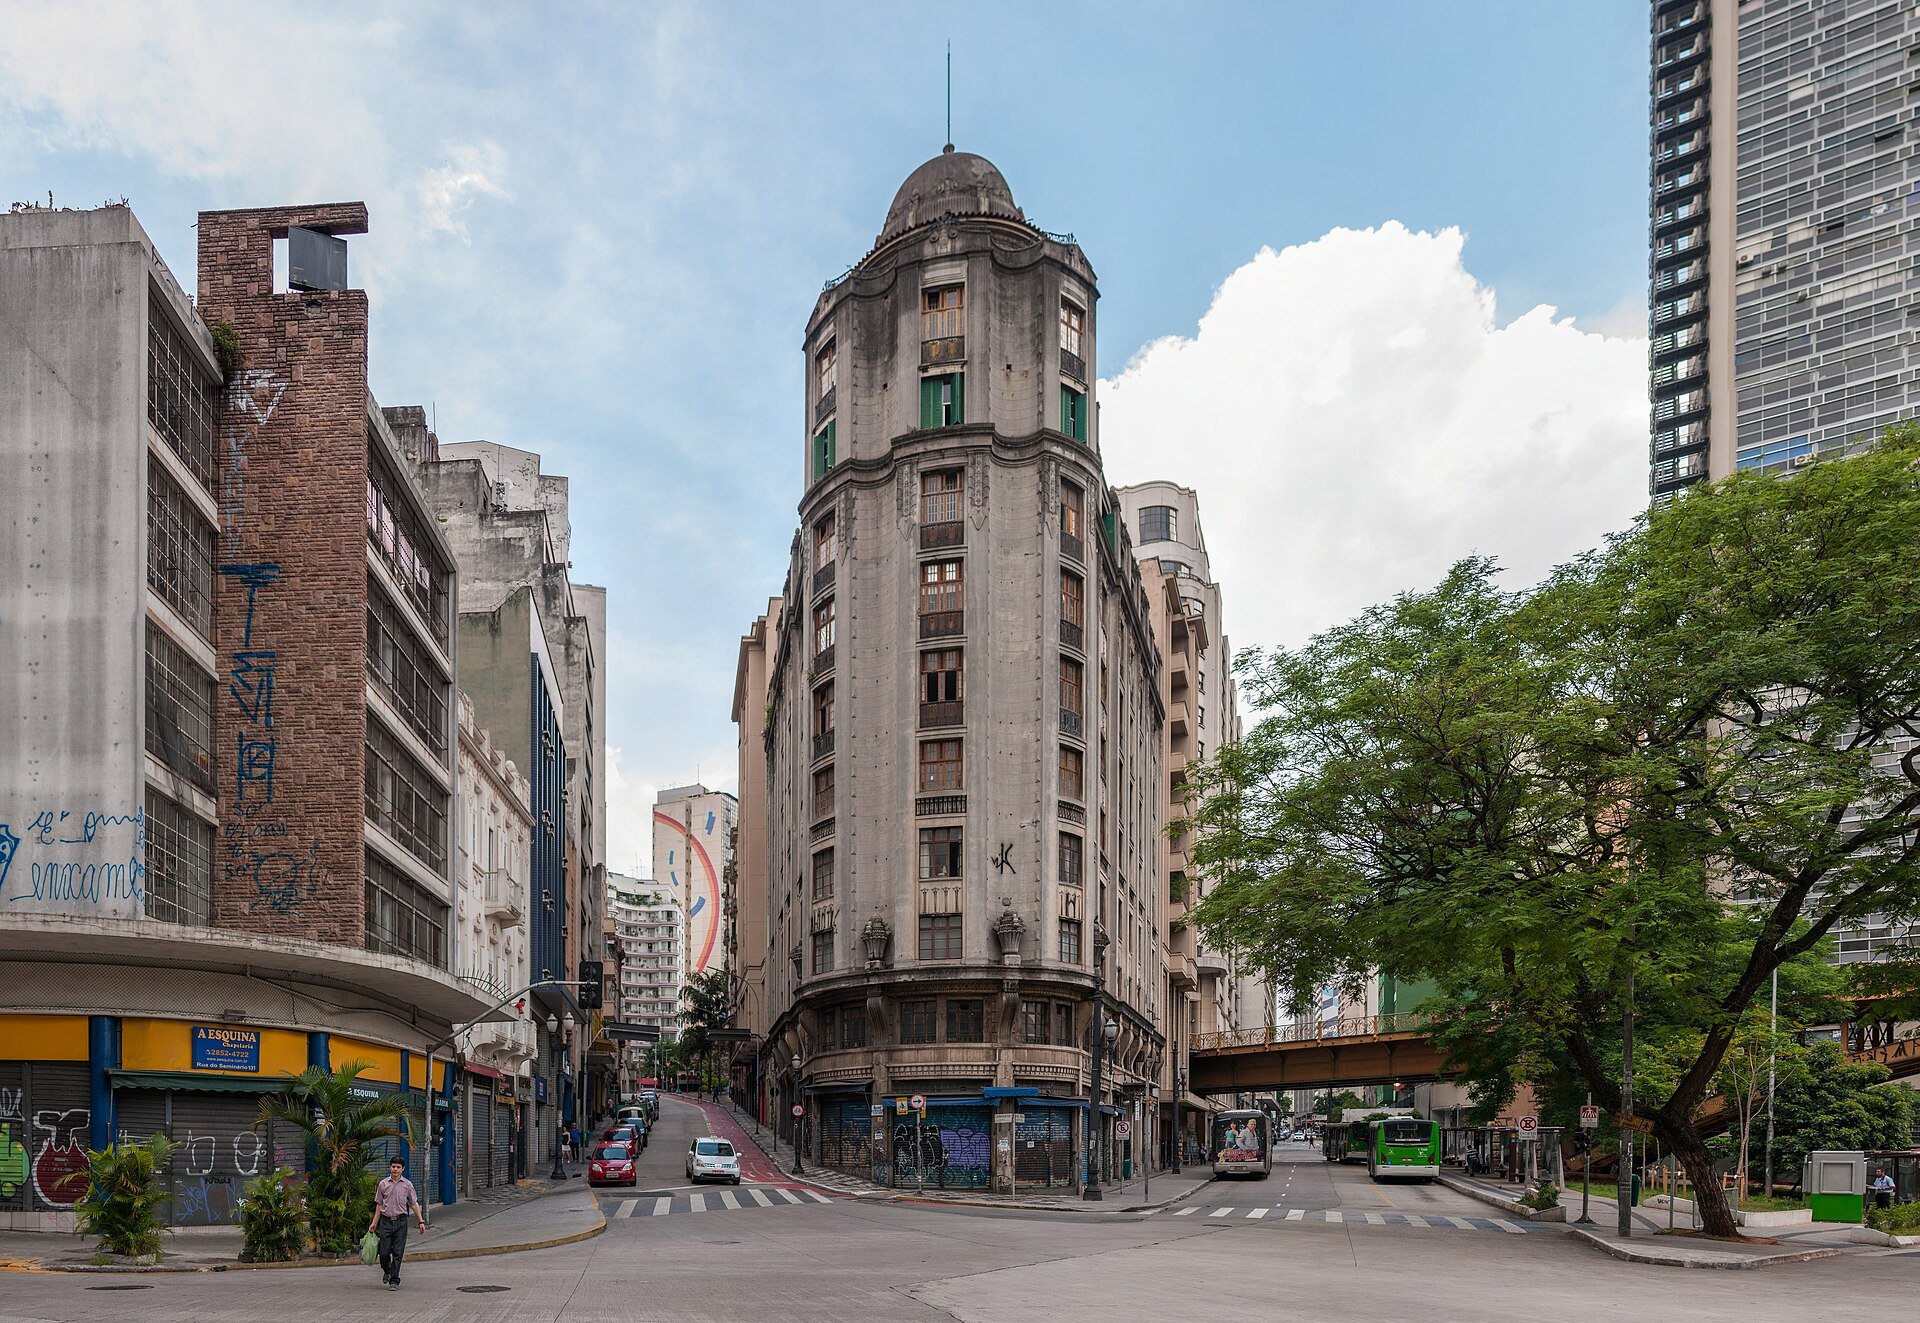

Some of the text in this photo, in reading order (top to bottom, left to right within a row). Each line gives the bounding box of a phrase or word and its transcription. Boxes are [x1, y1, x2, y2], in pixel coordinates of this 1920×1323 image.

[197, 1028, 256, 1042] A ESQUINA
[353, 1088, 379, 1099] ESQUINA
